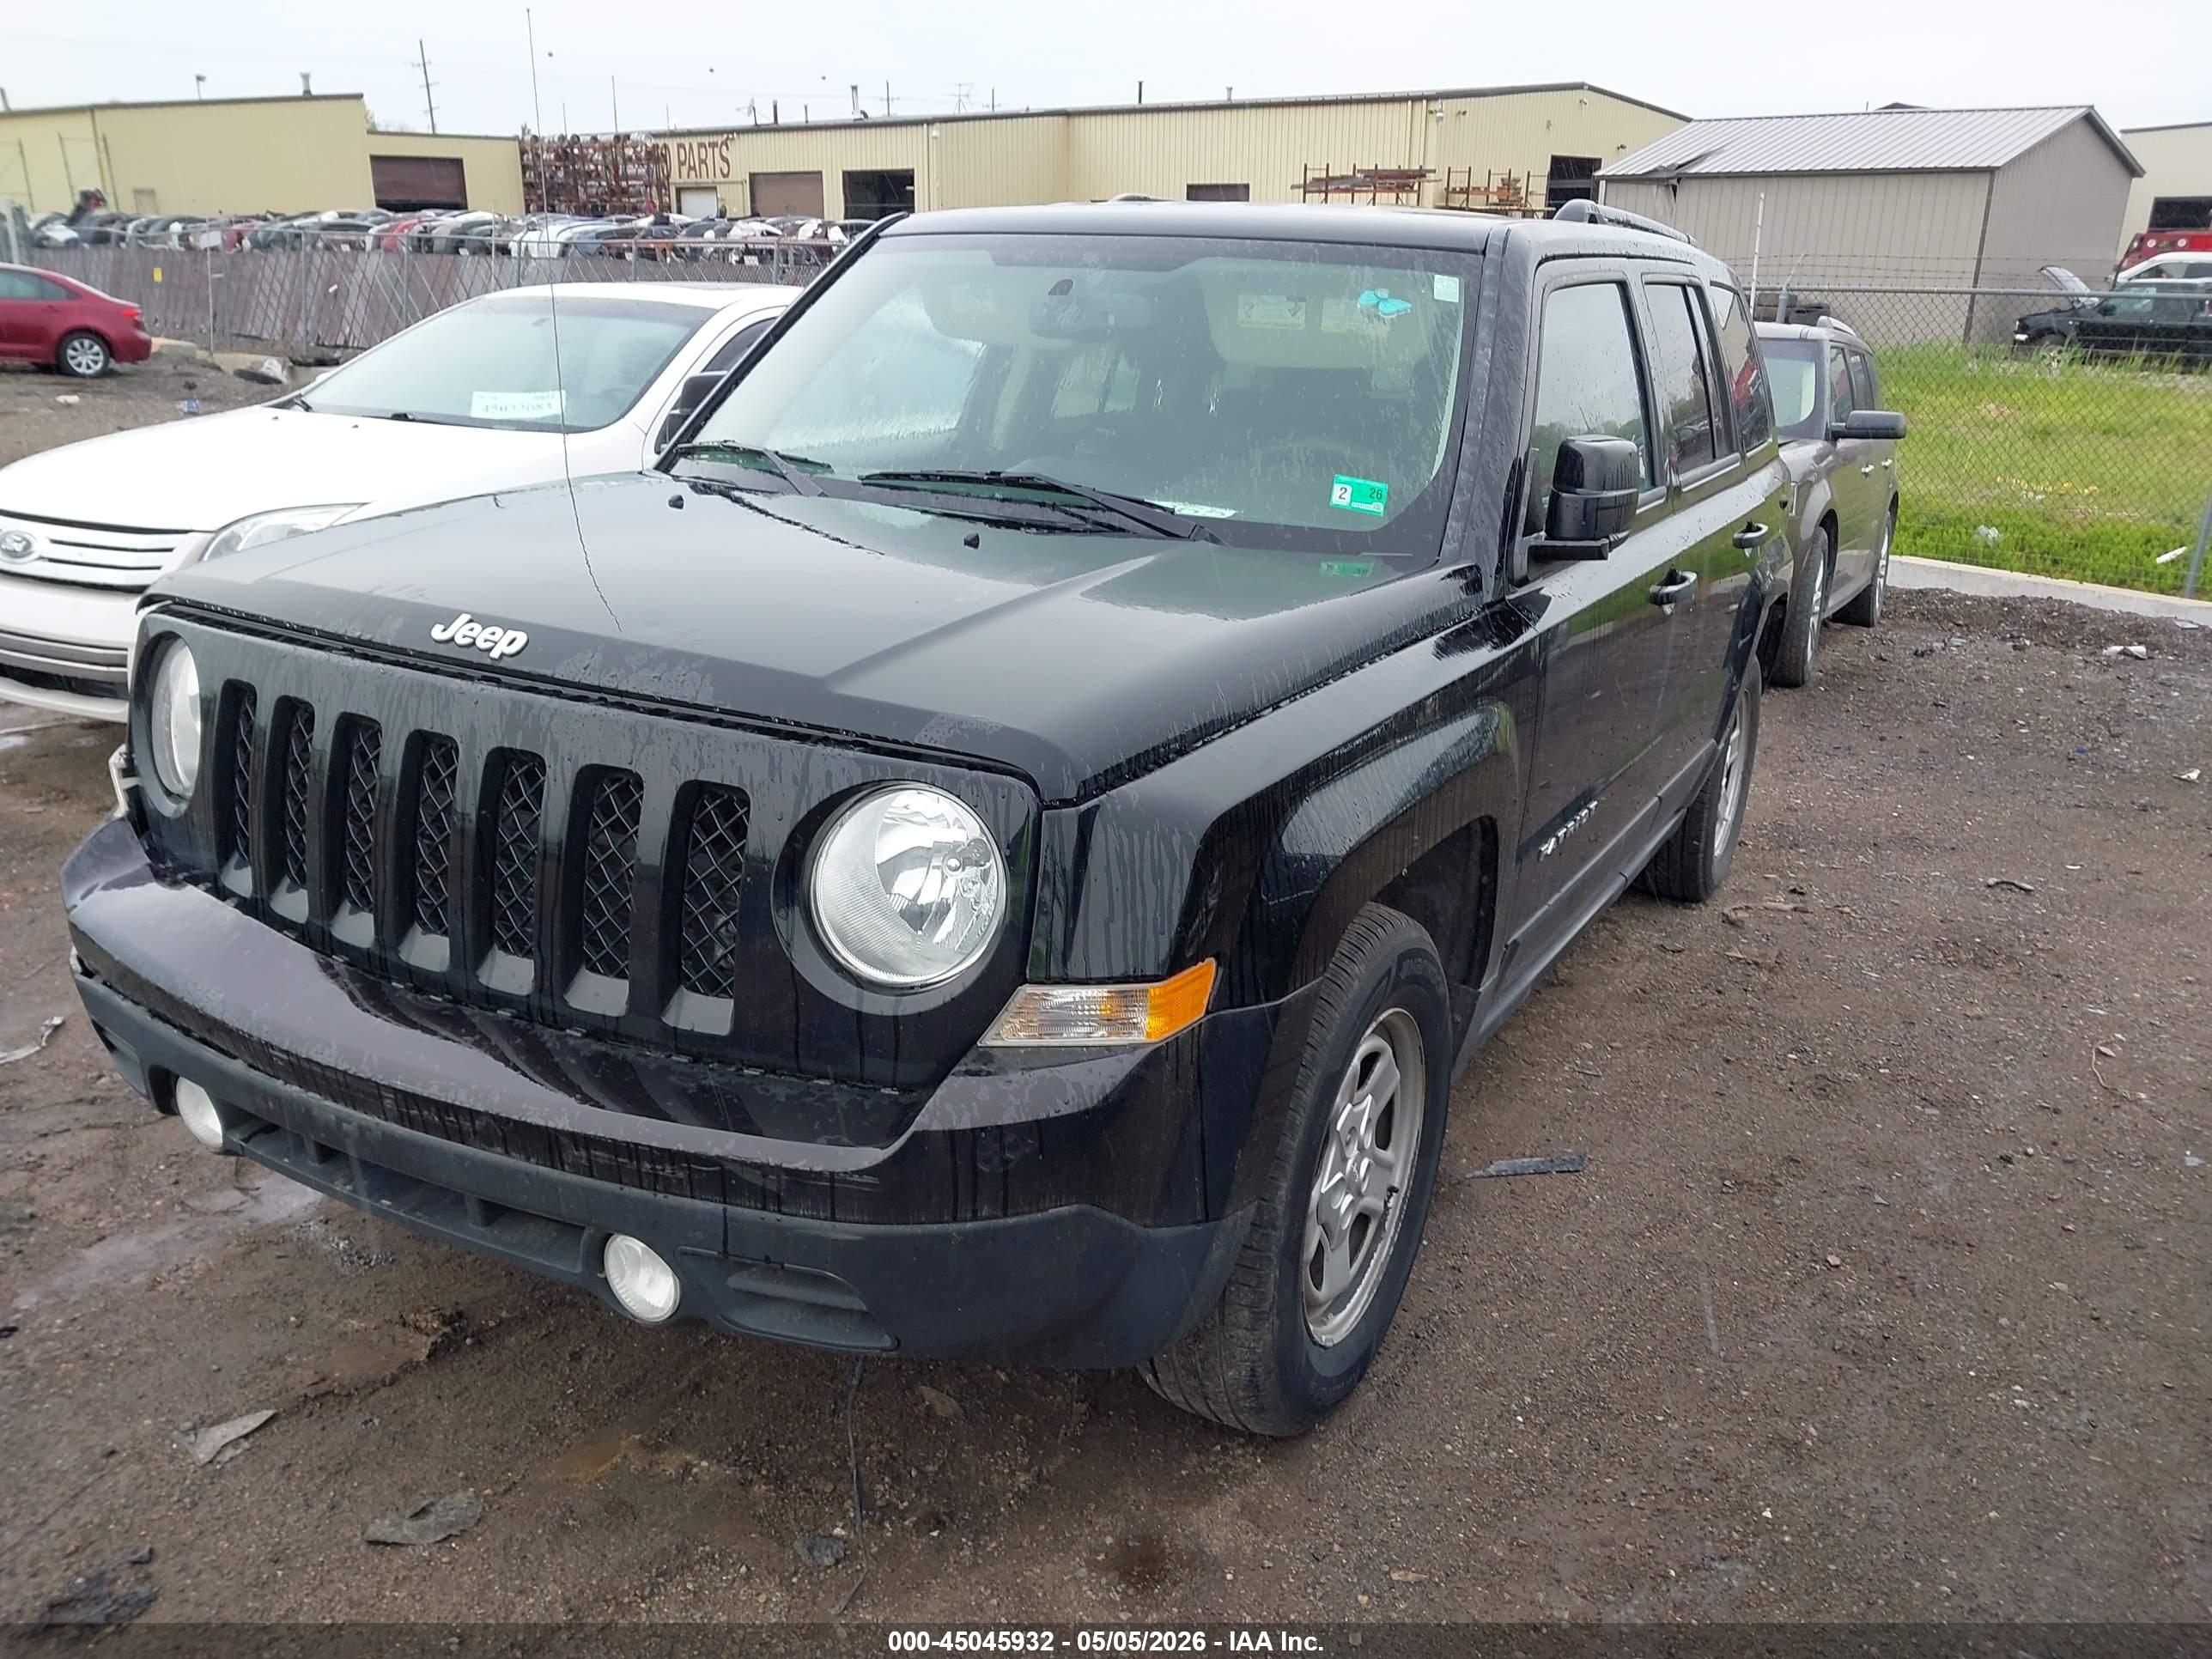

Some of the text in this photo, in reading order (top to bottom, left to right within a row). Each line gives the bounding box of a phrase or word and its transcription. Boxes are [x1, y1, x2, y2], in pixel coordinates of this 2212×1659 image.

[677, 139, 731, 179] PARTS
[1338, 487, 1383, 500] 2 26
[430, 612, 529, 659] Jeep
